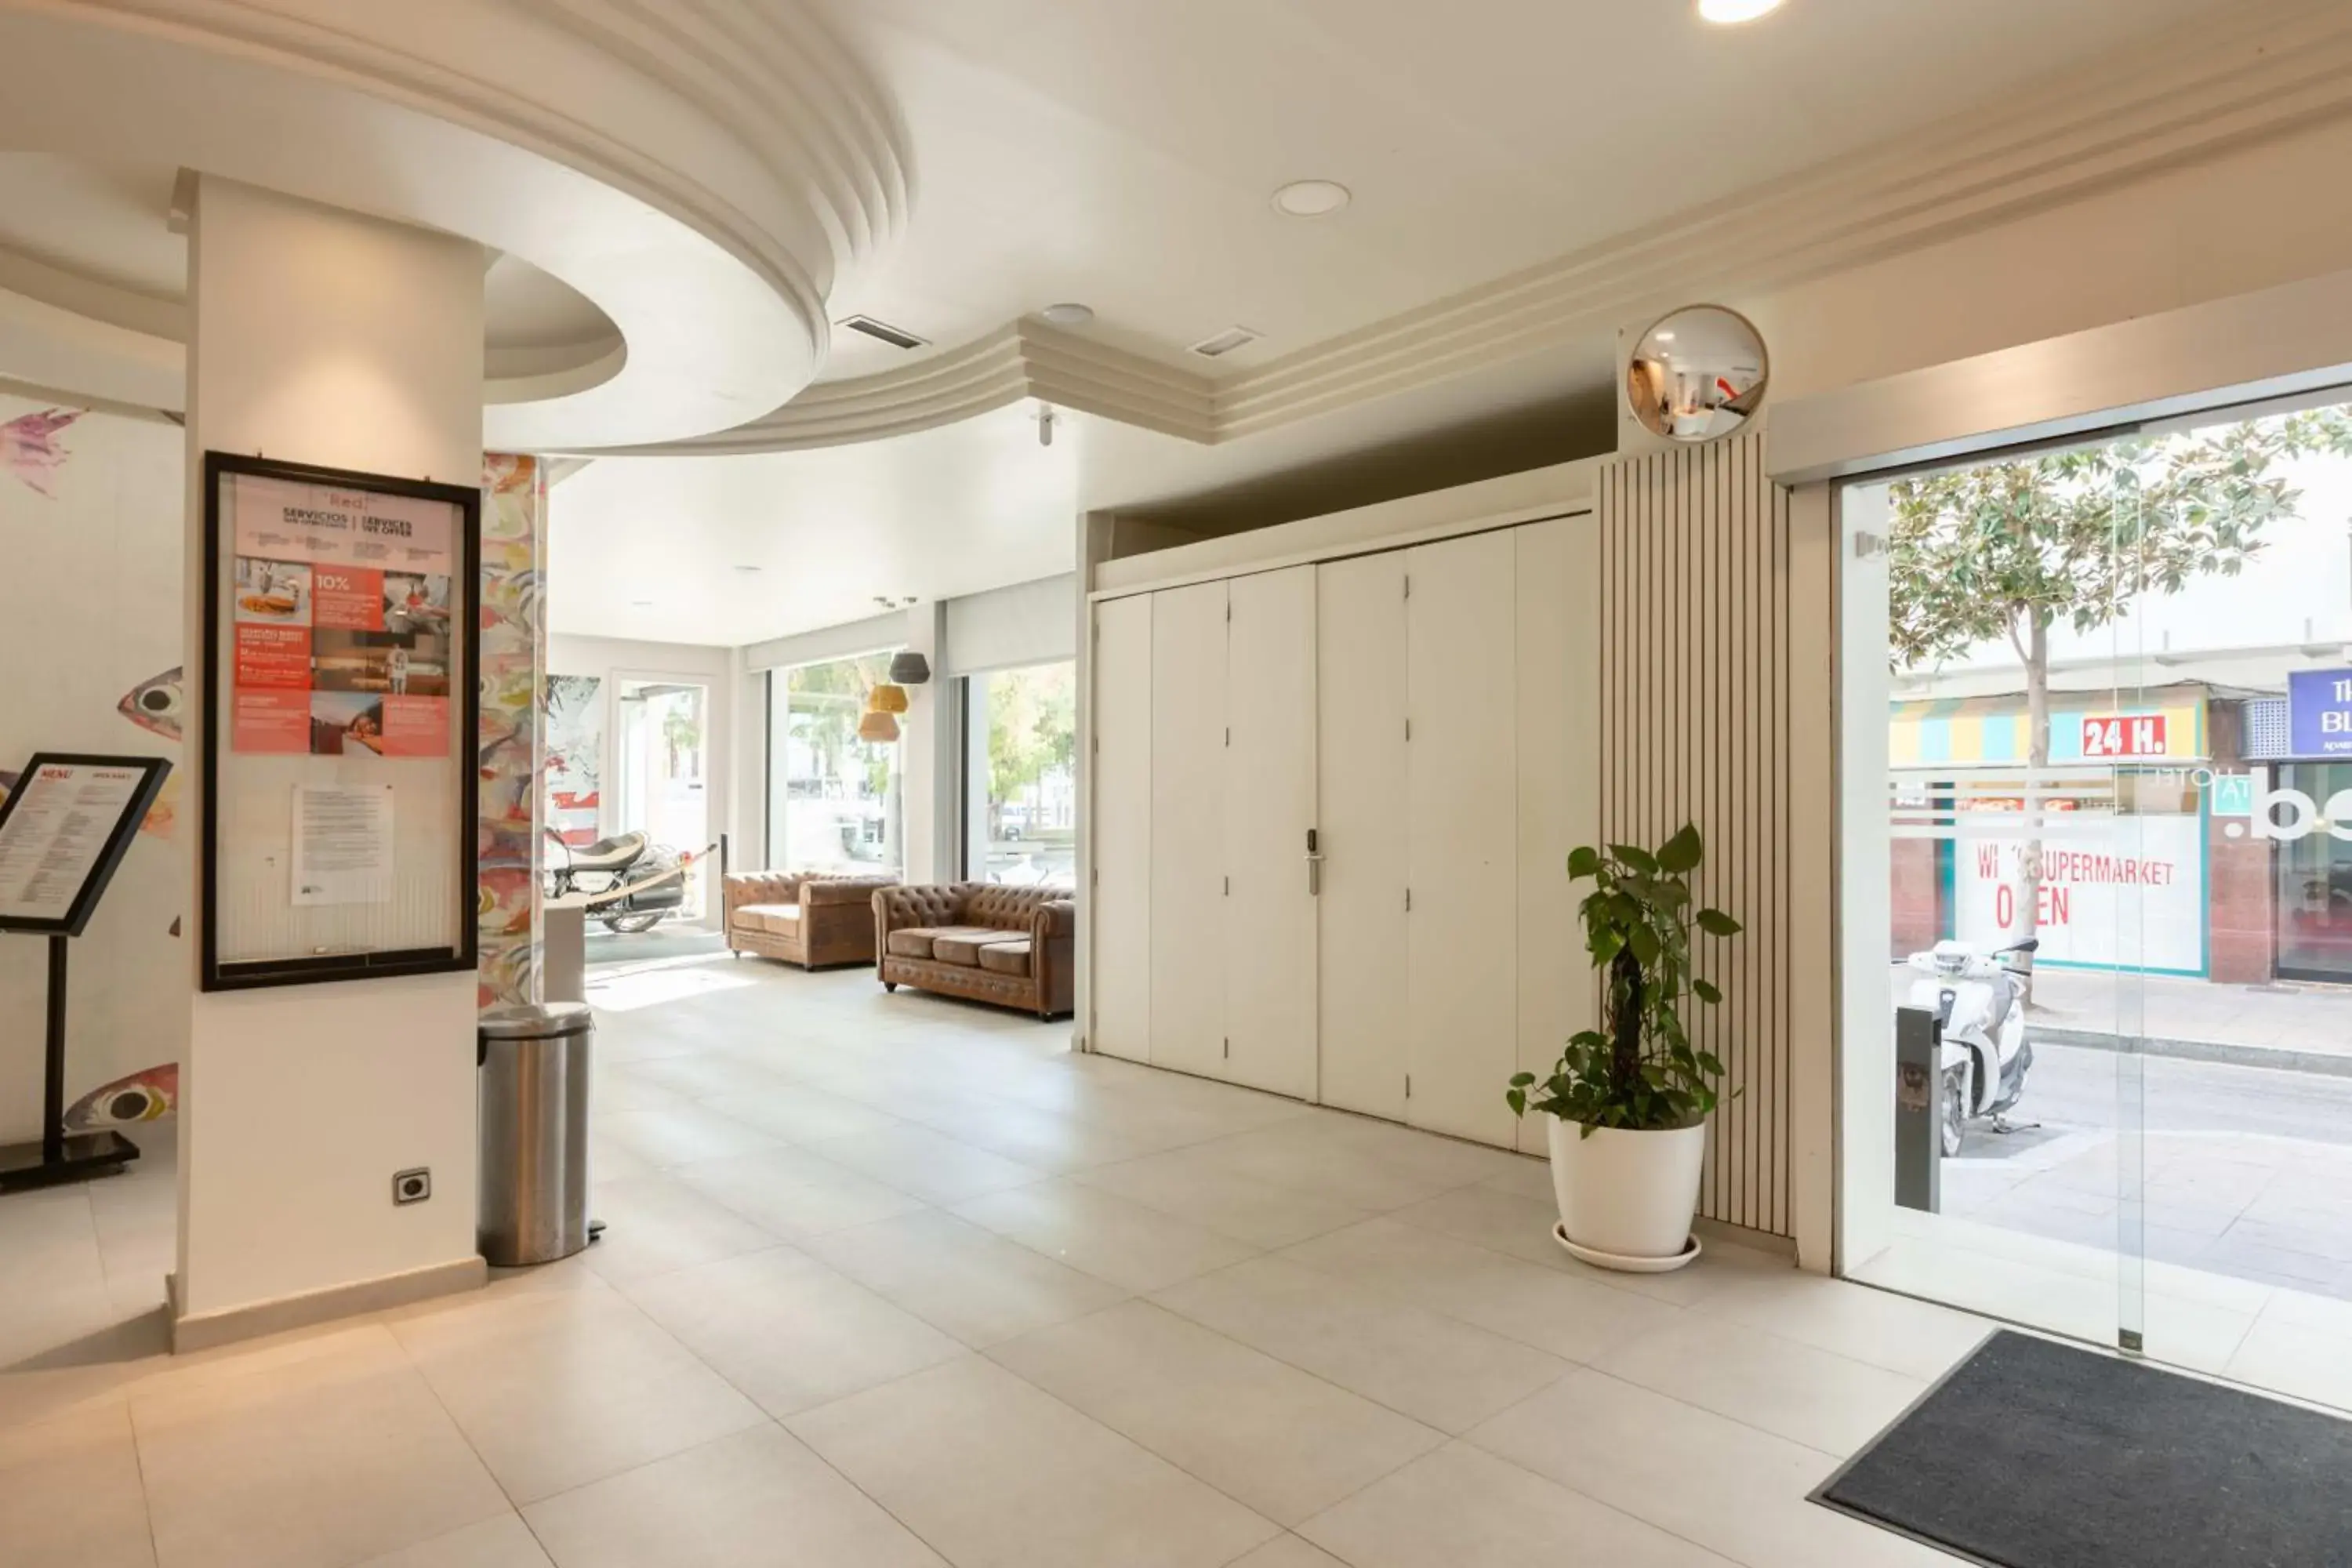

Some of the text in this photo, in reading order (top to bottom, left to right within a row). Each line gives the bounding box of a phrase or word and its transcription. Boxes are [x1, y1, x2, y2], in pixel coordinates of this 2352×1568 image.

[316, 575, 350, 591] 10%
[2085, 720, 2122, 755] 24
[1996, 884, 2069, 929] OEN
